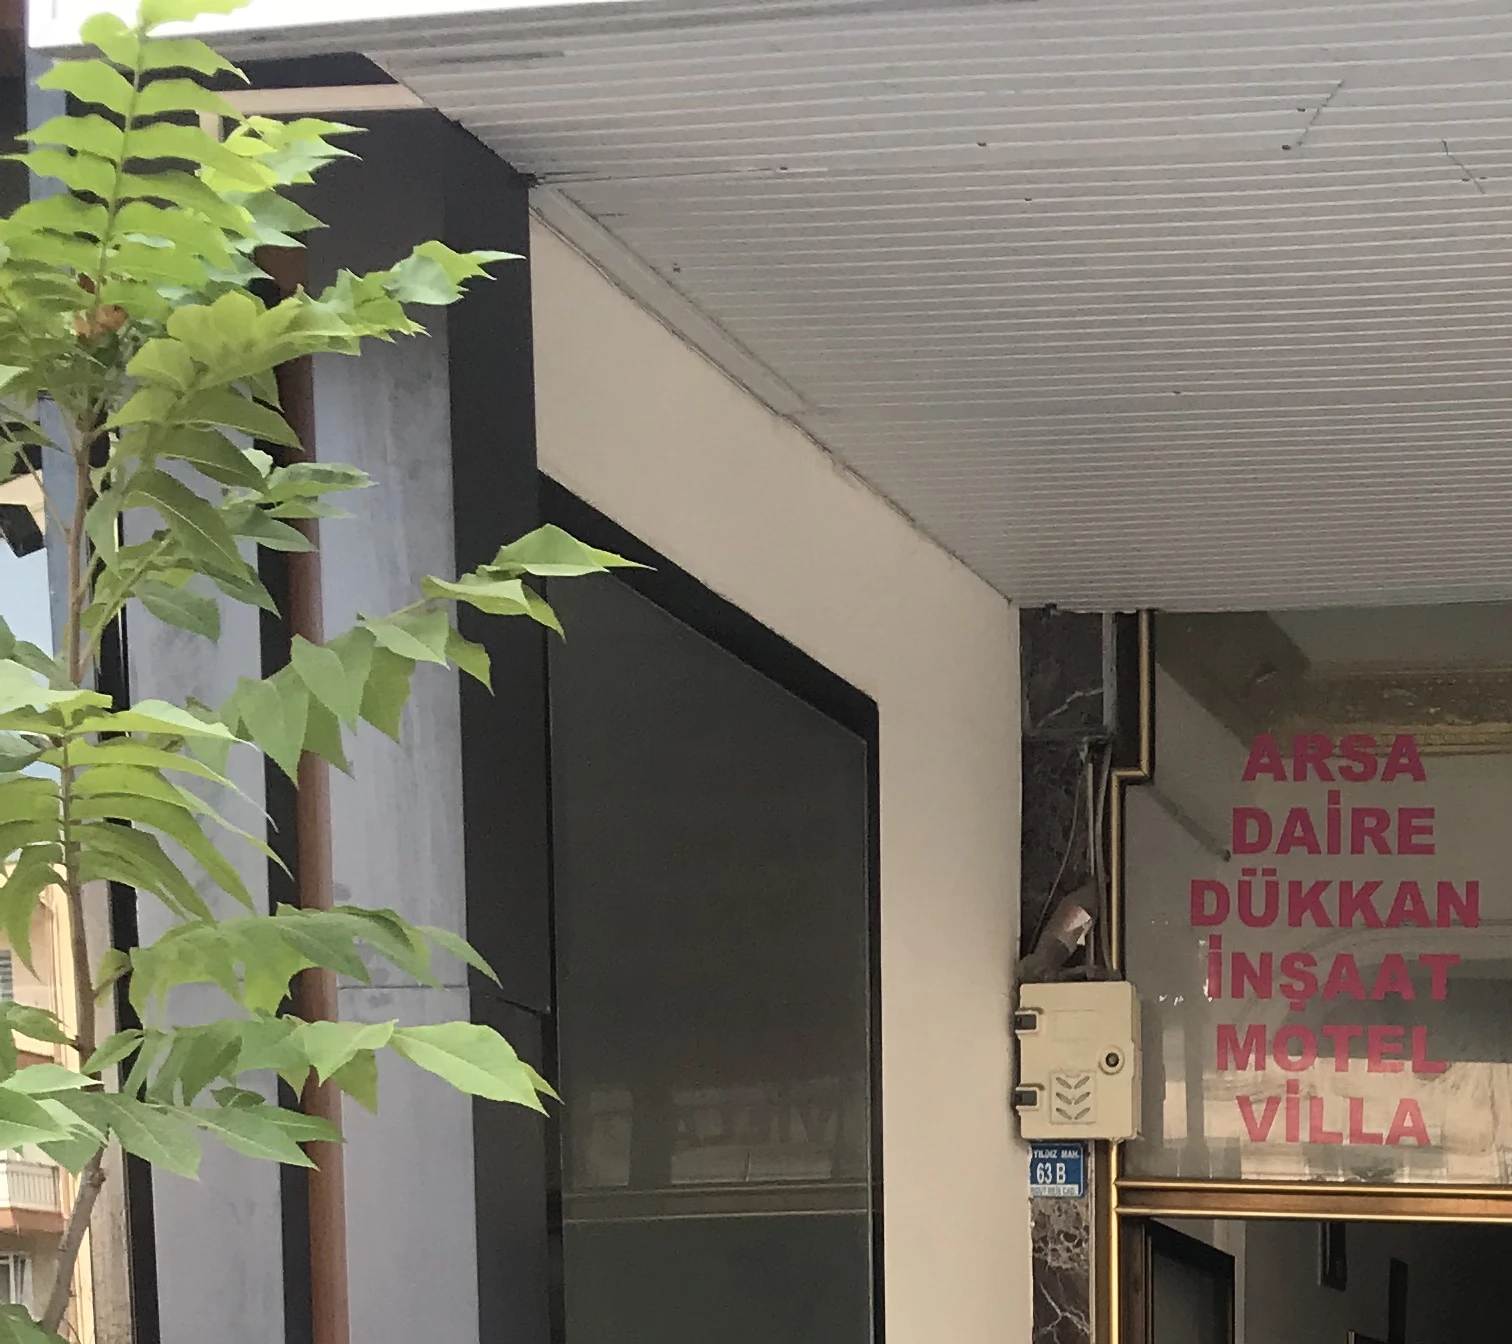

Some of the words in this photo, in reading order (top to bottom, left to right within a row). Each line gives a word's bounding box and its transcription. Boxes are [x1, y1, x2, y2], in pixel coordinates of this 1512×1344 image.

[1241, 734, 1427, 783] ARSA
[1232, 789, 1436, 856] DAİRE
[1190, 867, 1480, 929] DÜKKAN
[1206, 933, 1460, 1013] İNŞAAT
[1215, 1024, 1448, 1074] MOTEL
[1234, 1077, 1431, 1145] VİLLA
[1036, 1162, 1053, 1184] 63
[1056, 1162, 1067, 1184] B
